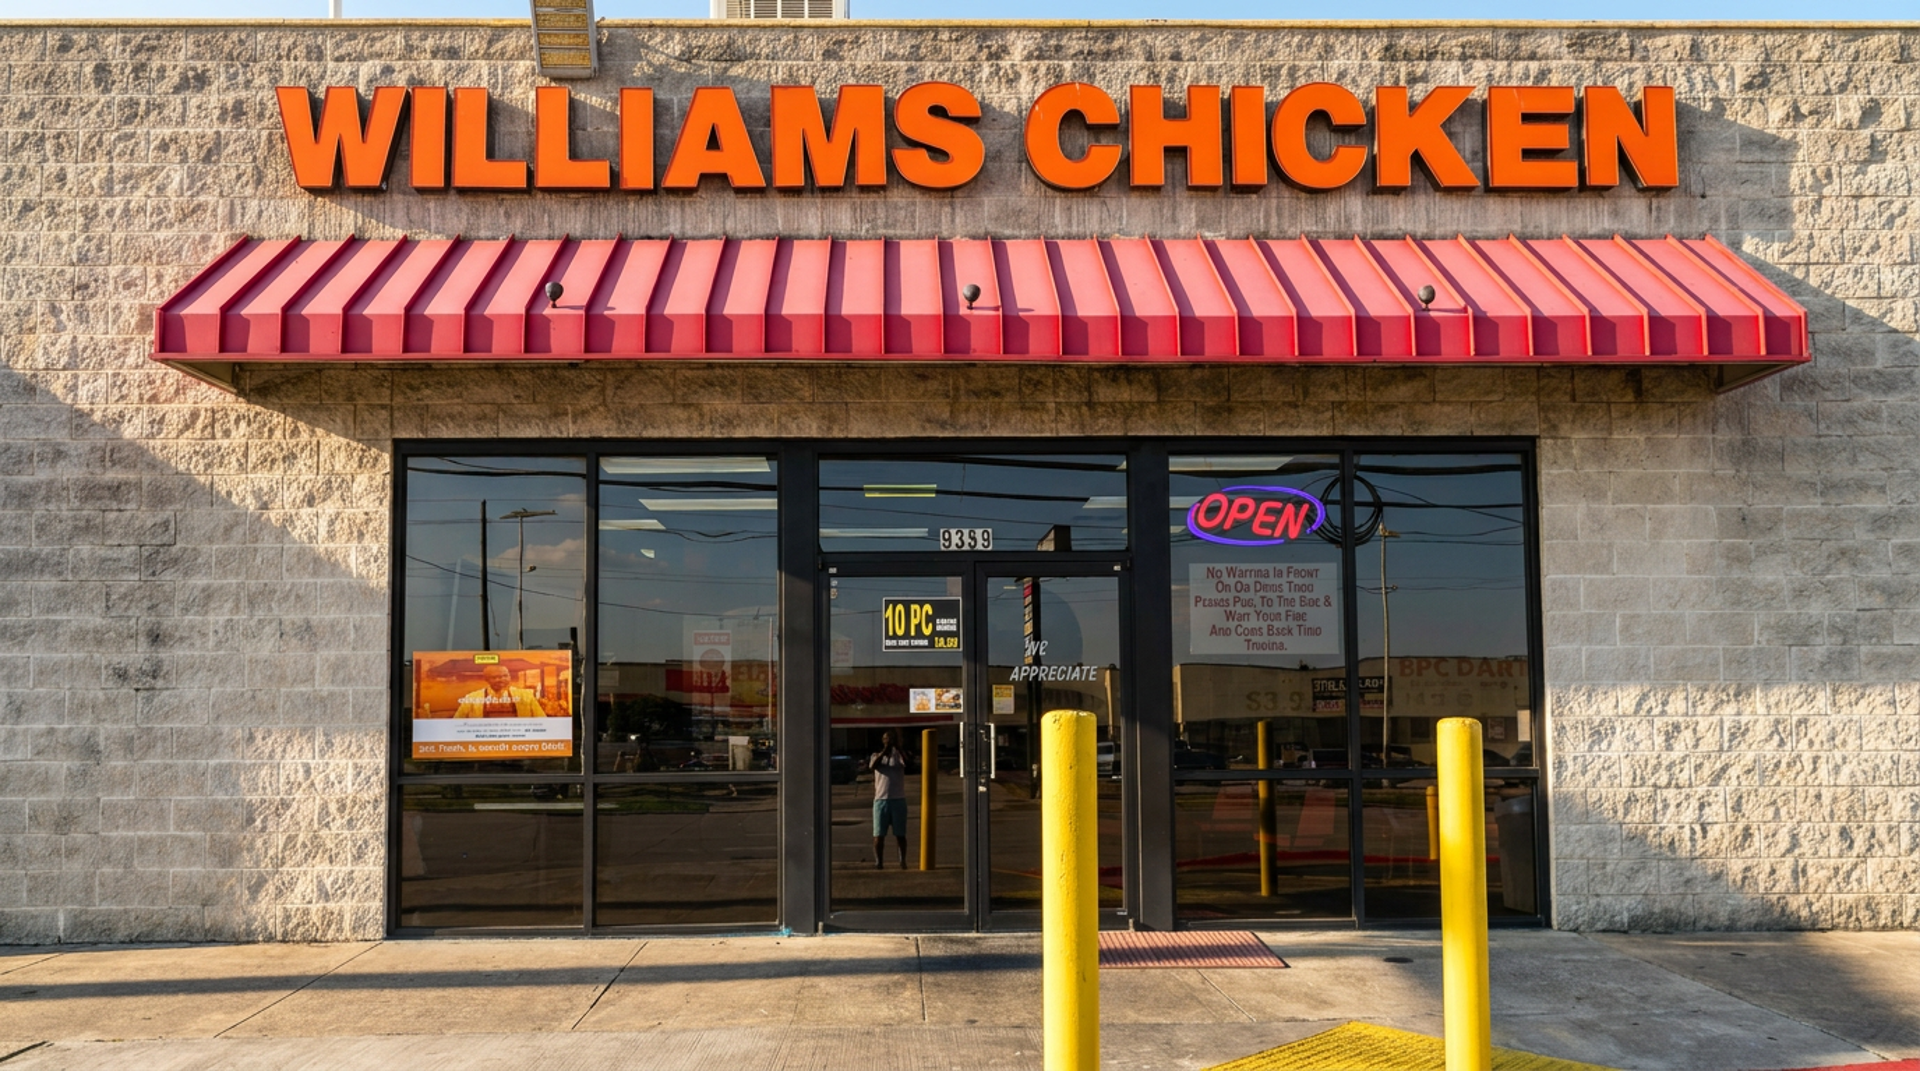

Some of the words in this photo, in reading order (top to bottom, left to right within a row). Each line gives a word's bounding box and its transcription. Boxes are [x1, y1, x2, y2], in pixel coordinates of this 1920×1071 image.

[275, 81, 986, 190] WILLIAMS
[1024, 81, 1680, 188] CHICKEN
[1197, 492, 1310, 539] OPEN
[1206, 566, 1223, 579] No
[885, 603, 906, 637] 10
[910, 603, 933, 637] PC
[1009, 665, 1098, 681] APPRECIATE
